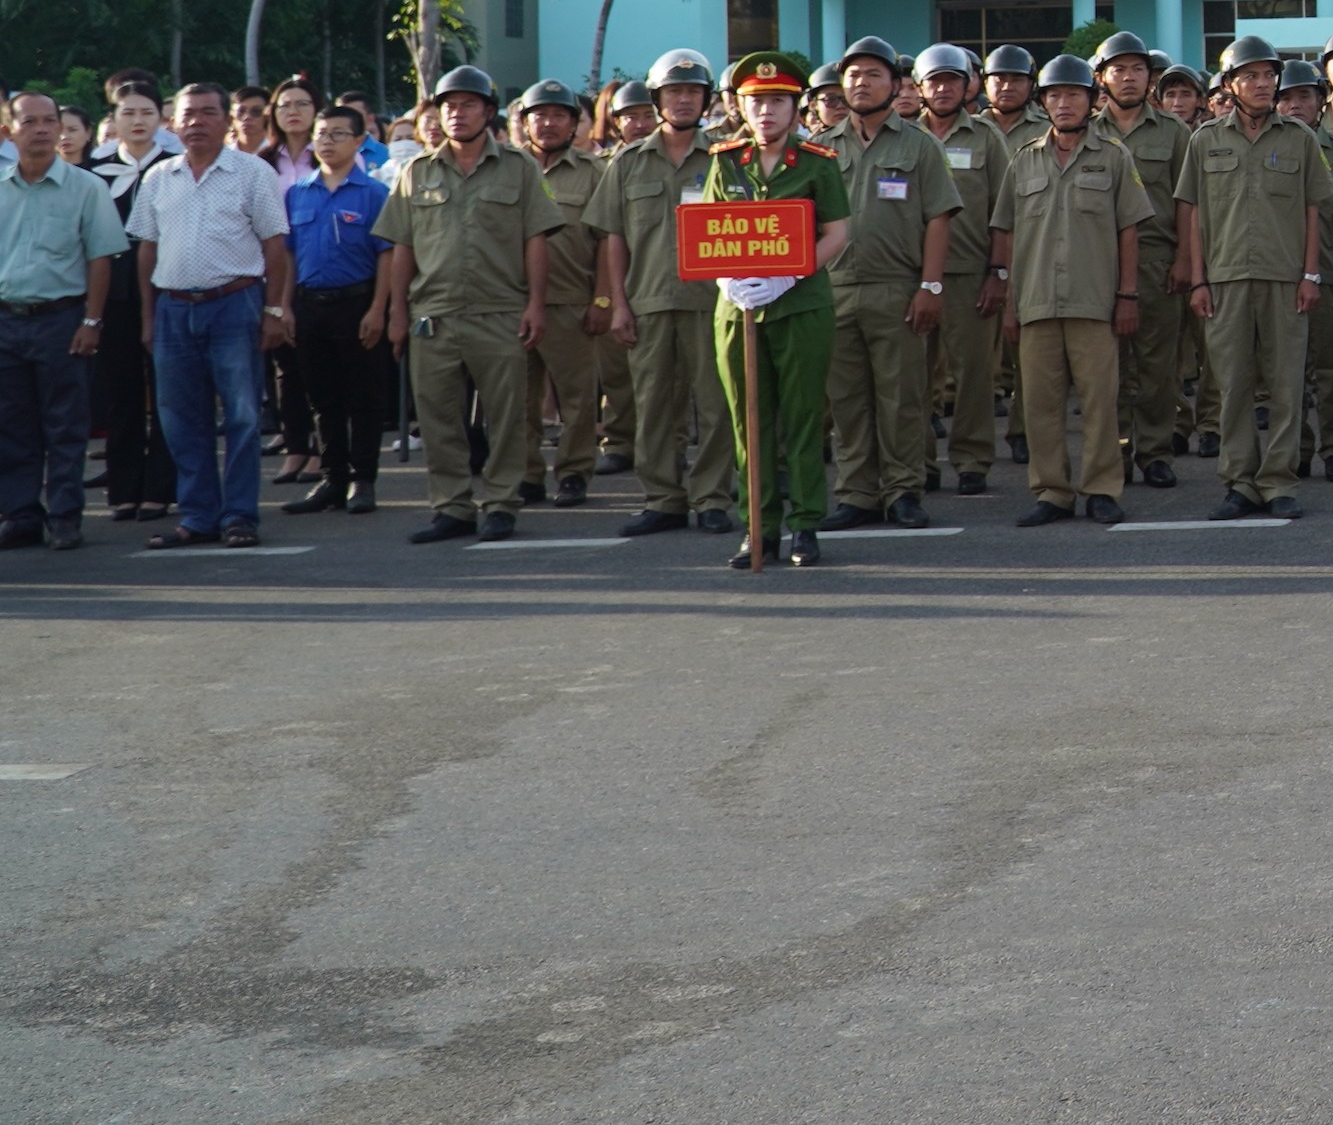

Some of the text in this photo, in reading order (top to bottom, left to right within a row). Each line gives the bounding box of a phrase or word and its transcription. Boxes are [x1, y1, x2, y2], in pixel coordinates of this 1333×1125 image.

[707, 213, 780, 237] BẢO VỆ
[698, 233, 790, 258] DÂN PHỐ
